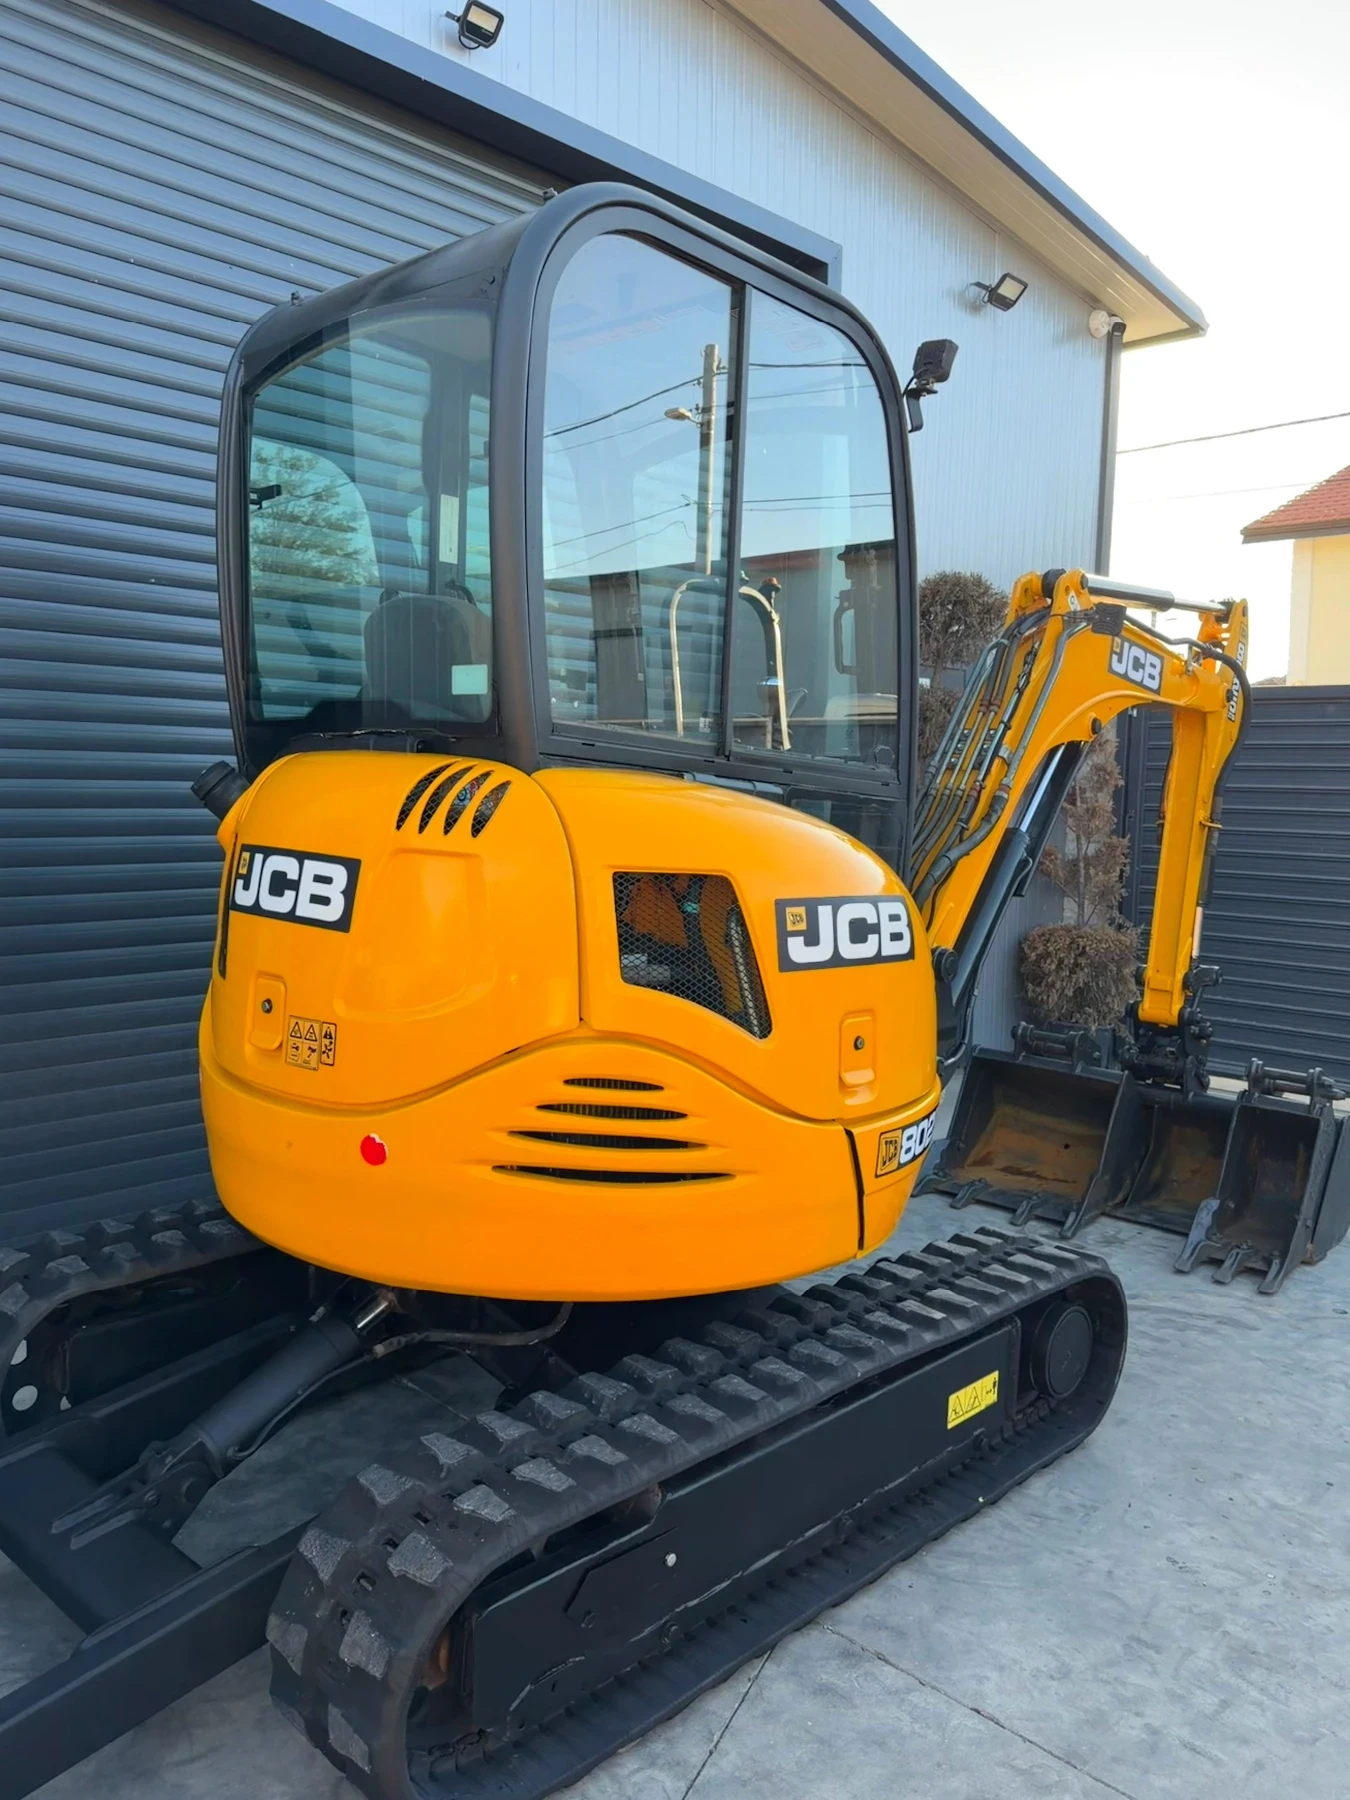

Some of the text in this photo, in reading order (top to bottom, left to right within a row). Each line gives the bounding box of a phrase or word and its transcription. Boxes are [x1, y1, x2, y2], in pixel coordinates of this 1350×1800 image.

[1111, 642, 1161, 690] JCB
[234, 852, 348, 922] JCB
[788, 902, 911, 963] JCB
[882, 1139, 898, 1167] JCB
